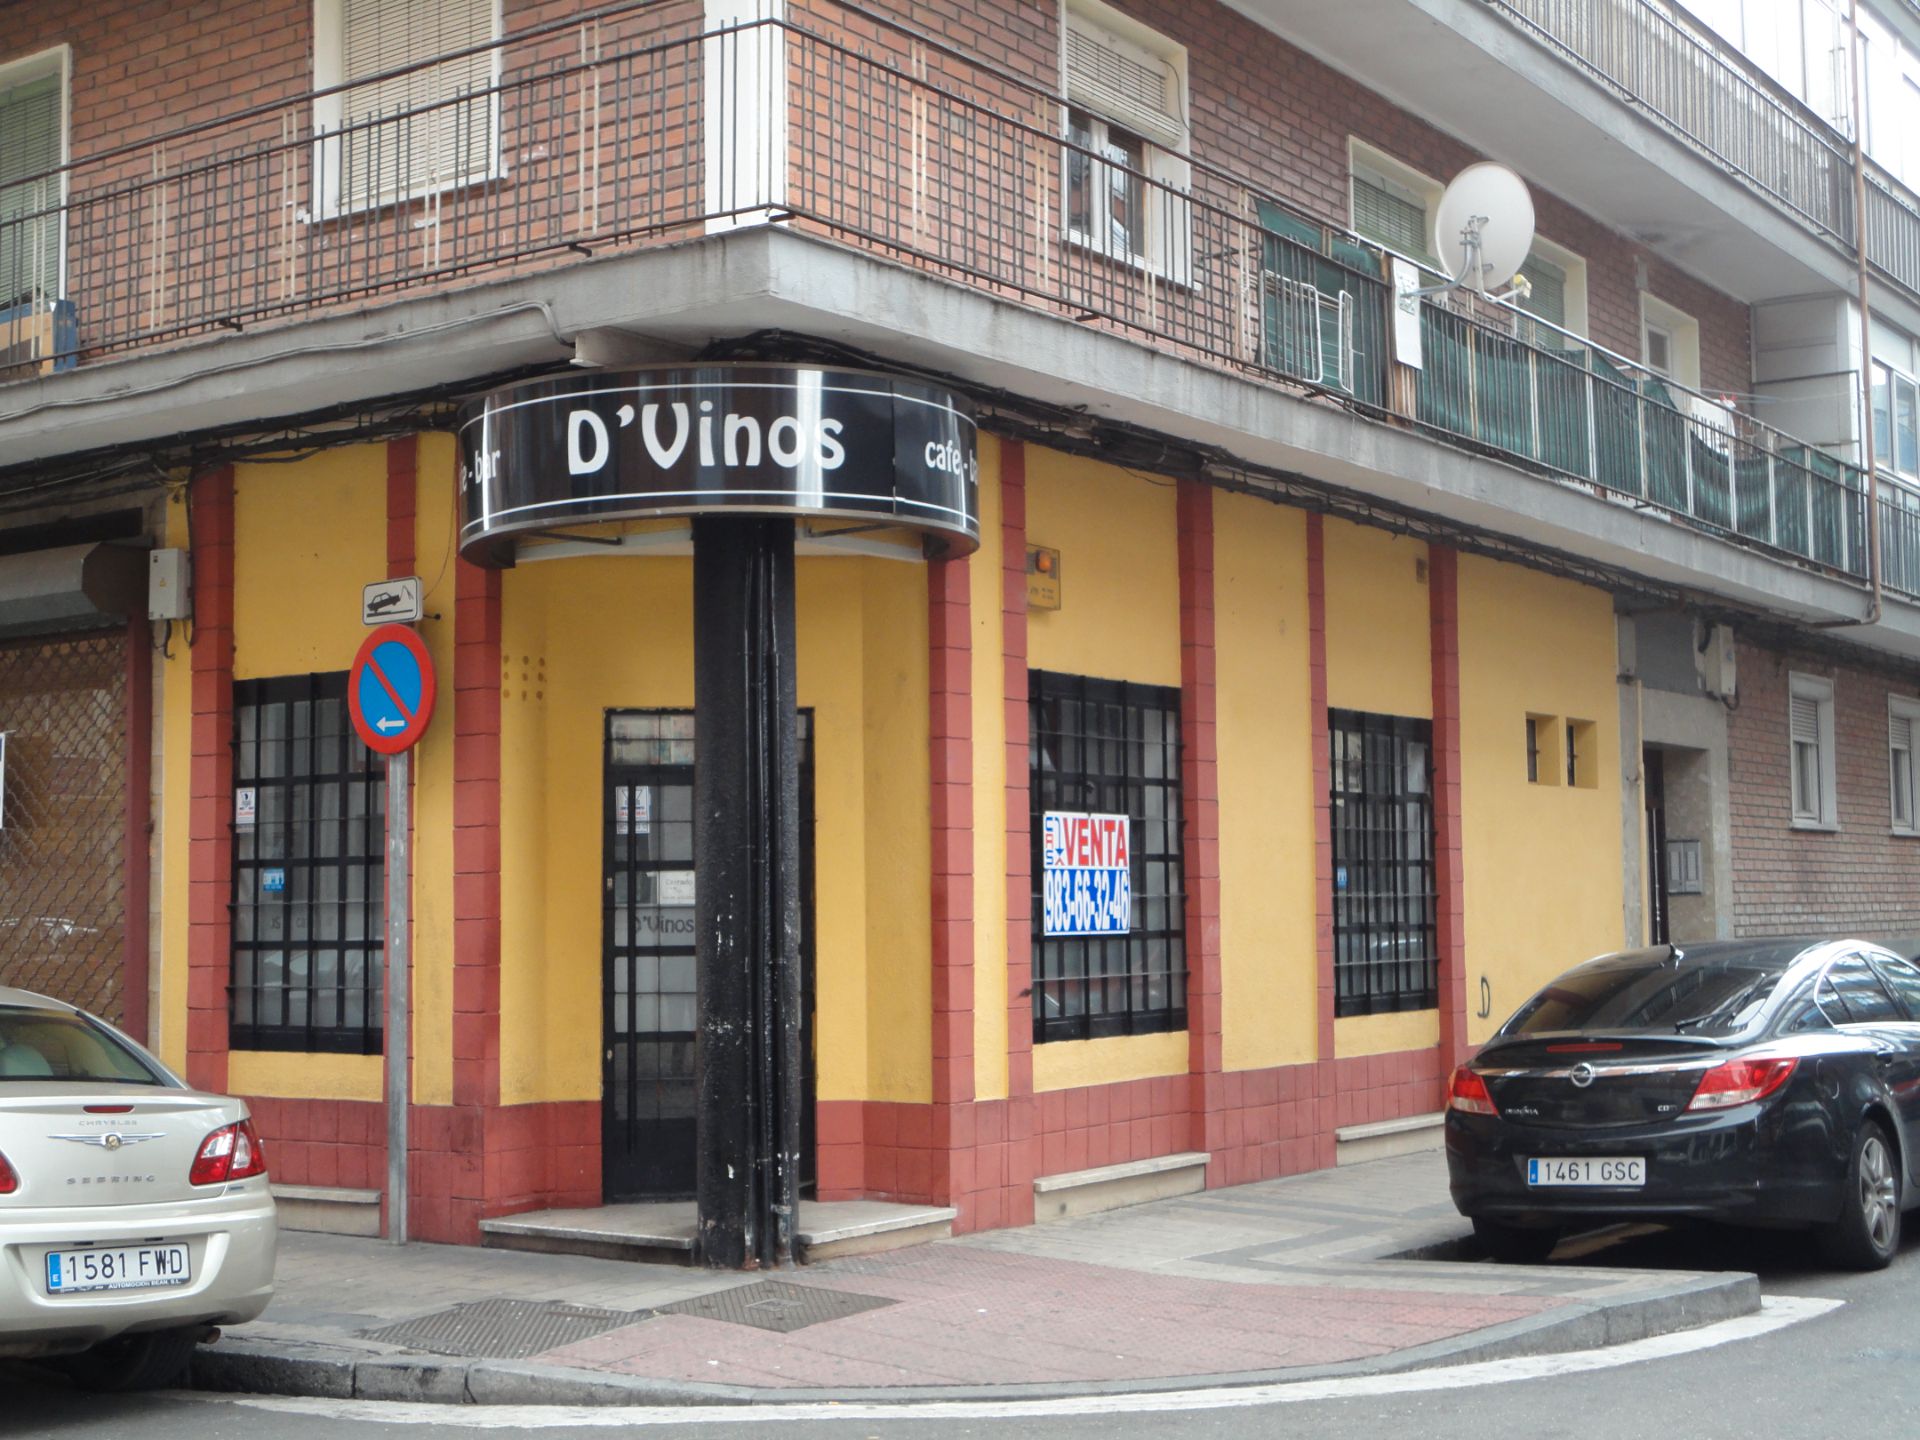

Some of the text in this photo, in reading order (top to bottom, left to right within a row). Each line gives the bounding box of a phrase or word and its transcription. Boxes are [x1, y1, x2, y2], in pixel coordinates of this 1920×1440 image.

[568, 400, 845, 475] D'Vinos
[1063, 817, 1128, 867] VENTA
[1046, 869, 1129, 932] 983-66-32-46
[1545, 1162, 1640, 1181] 1461 GSC
[69, 1249, 183, 1282] 1581 FWD
